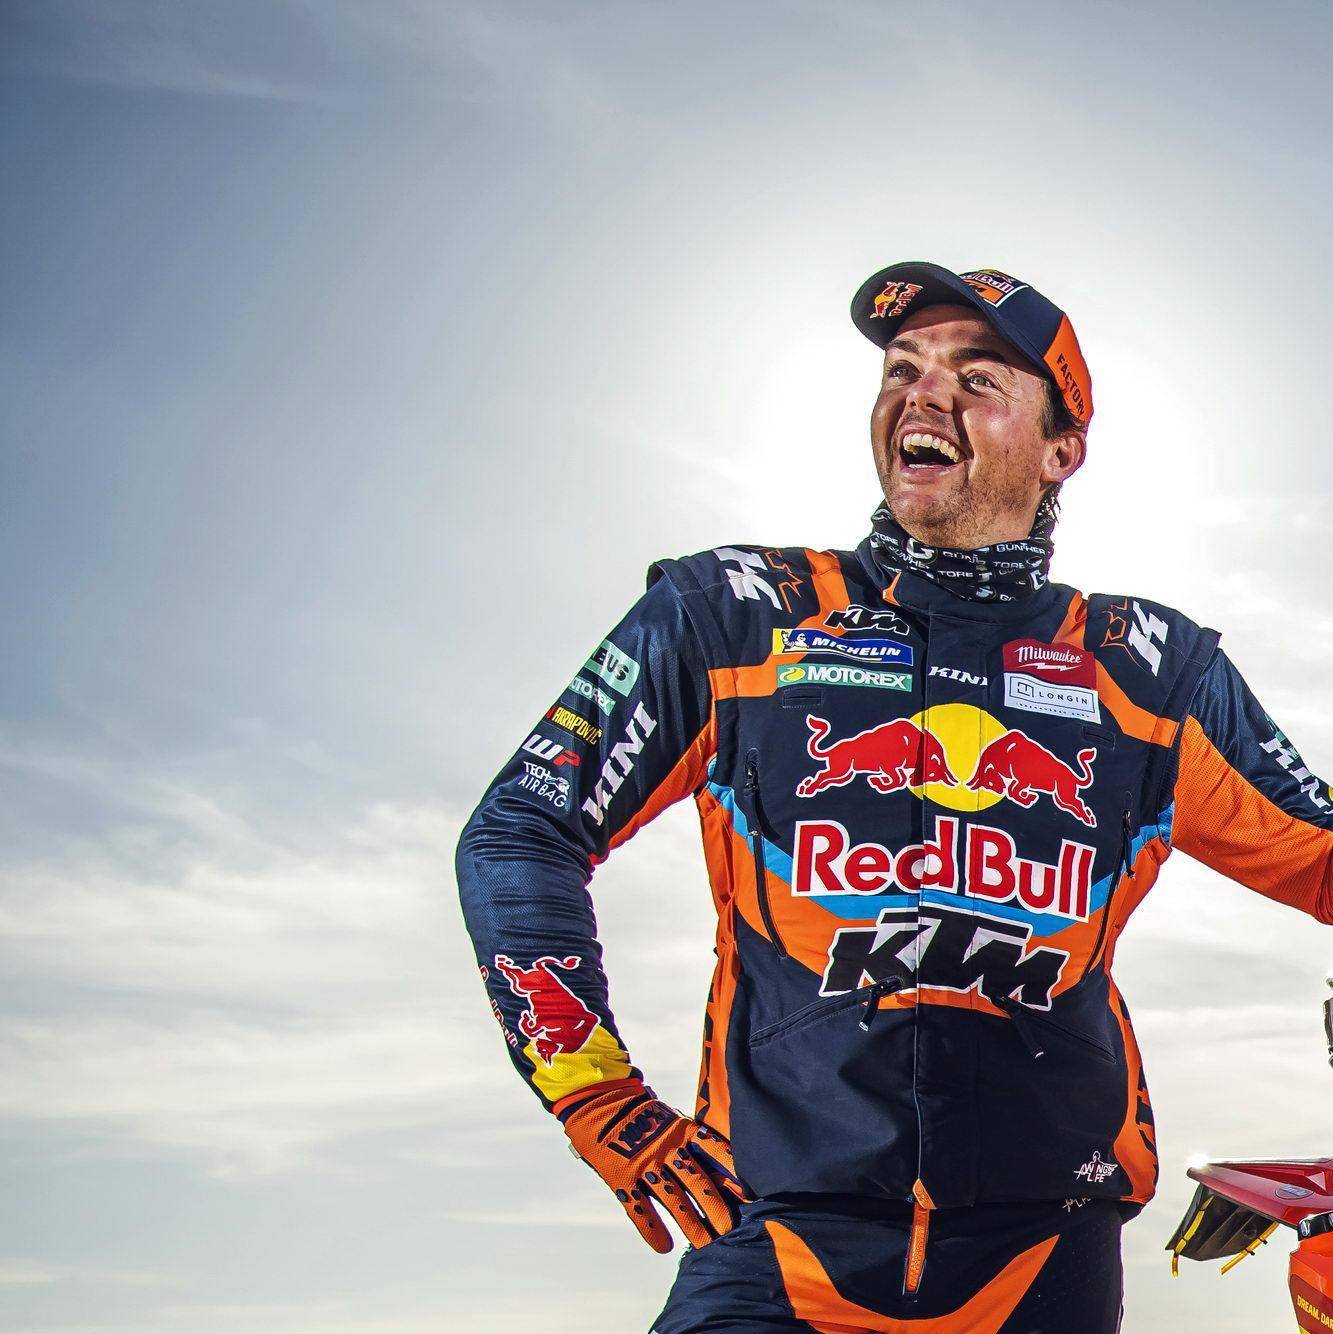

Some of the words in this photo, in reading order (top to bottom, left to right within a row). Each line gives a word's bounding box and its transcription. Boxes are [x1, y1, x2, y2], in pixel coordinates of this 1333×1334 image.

[938, 570, 974, 578] TORE
[823, 604, 910, 635] KTM
[811, 637, 901, 656] MICHELIN
[1014, 646, 1083, 664] Milwaukee
[807, 665, 907, 690] MOTOREX
[1039, 691, 1088, 705] LONGIN
[792, 816, 959, 897] Red
[965, 823, 1096, 924] Bull
[818, 902, 1075, 1011] KTM
[1297, 1294, 1320, 1320] DREAM.
